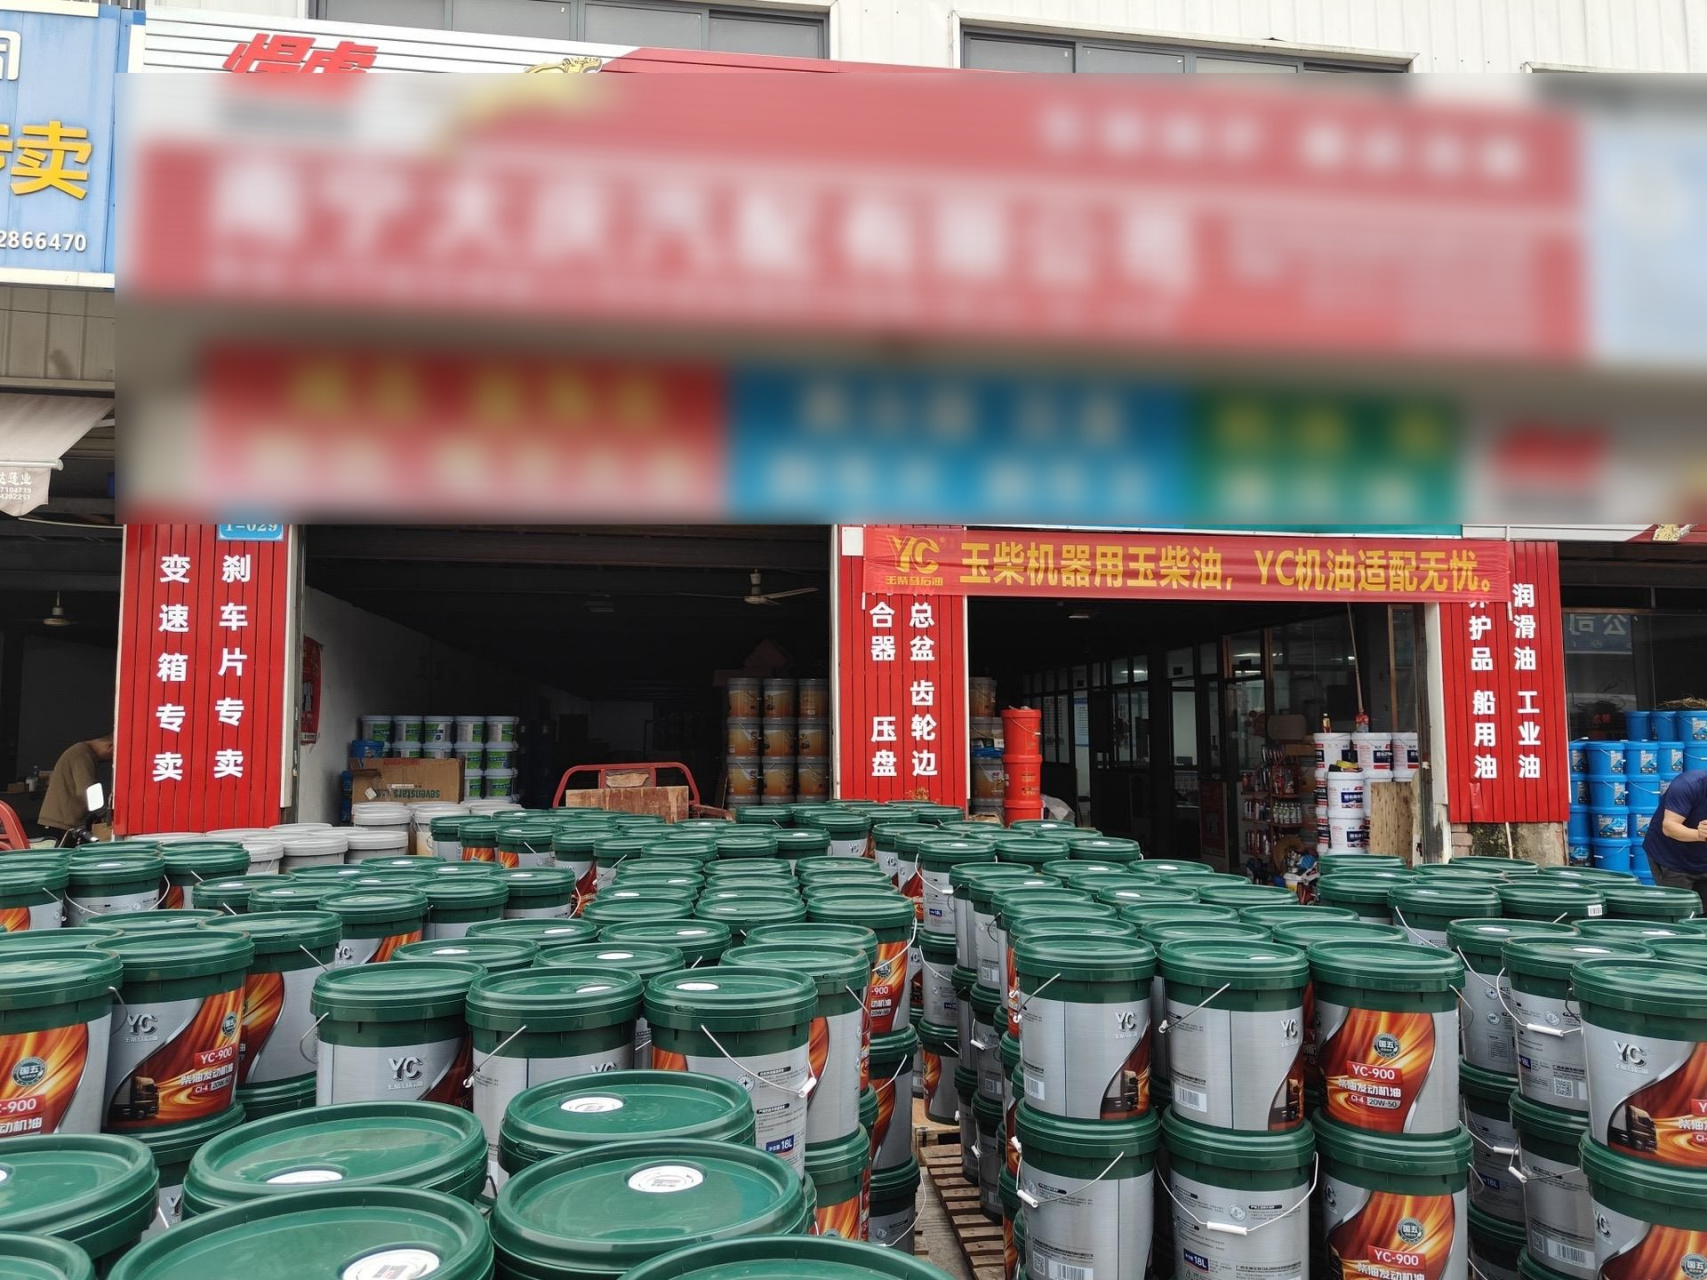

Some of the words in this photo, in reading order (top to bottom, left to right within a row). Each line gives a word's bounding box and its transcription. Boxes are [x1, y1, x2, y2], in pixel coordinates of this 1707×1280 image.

[0, 120, 92, 200] 卖
[0, 229, 87, 253] 2866470
[886, 534, 940, 573] YC
[869, 594, 896, 661] 合器
[909, 594, 936, 661] 总盆
[1469, 601, 1494, 671] 护品
[1512, 583, 1536, 671] 润滑油
[152, 553, 191, 782] 变速箱专卖
[214, 554, 251, 779] 刹车片专卖
[910, 679, 938, 777] 齿轮边
[1472, 690, 1498, 779] 船用油
[1517, 691, 1541, 779] 工业油
[871, 716, 897, 777] 压盘
[871, 986, 888, 995] -900
[127, 1013, 158, 1036] YC
[1115, 1011, 1137, 1032] YC
[1280, 1018, 1298, 1040] YC
[201, 1047, 233, 1065] YC-900
[1613, 1040, 1647, 1067] YC
[387, 1056, 424, 1082] YC
[1352, 1064, 1395, 1080] YC-900
[0, 1098, 37, 1113] -900
[1679, 1117, 1707, 1131] 柴油
[166, 1194, 182, 1216] Y
[1374, 1249, 1419, 1266] YC-900
